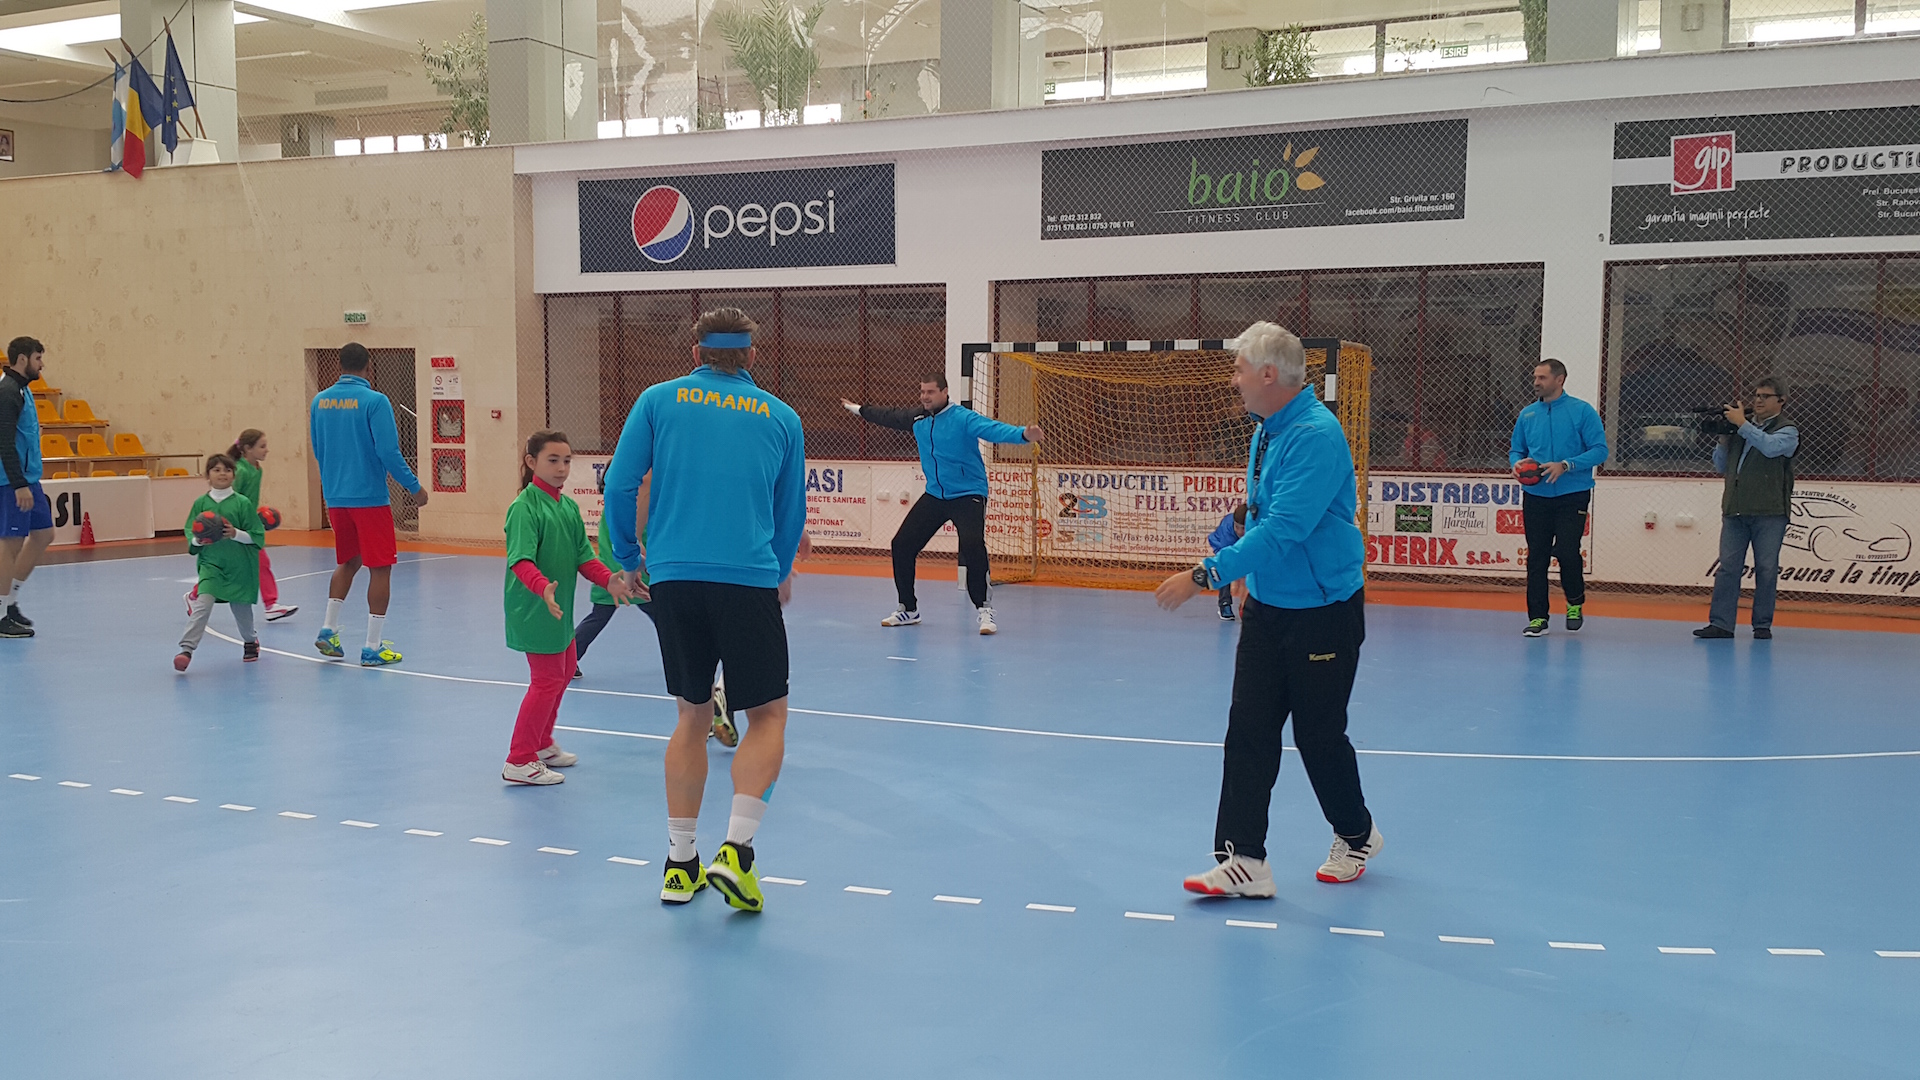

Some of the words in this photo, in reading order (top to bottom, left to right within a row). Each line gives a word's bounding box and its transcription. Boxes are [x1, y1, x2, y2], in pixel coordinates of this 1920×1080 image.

[1673, 138, 1731, 190] gip
[1188, 156, 1290, 206] baio
[1883, 186, 1920, 195] Bucures
[704, 189, 835, 249] pepsi
[1187, 213, 1240, 225] FITNESS
[1255, 210, 1289, 221] CLUB
[1638, 205, 1686, 230] garantia
[1689, 208, 1724, 228] imaginii
[1727, 201, 1770, 229] perfecte
[318, 399, 359, 410] ROMANIA
[676, 387, 771, 419] ROMANIA
[1058, 472, 1168, 491] PRODUCTIE
[832, 496, 867, 505] SANITARE
[1135, 495, 1179, 511] FULL
[1454, 507, 1475, 518] Perla
[1466, 551, 1509, 565] S.R.L.
[1840, 562, 1863, 584] la
